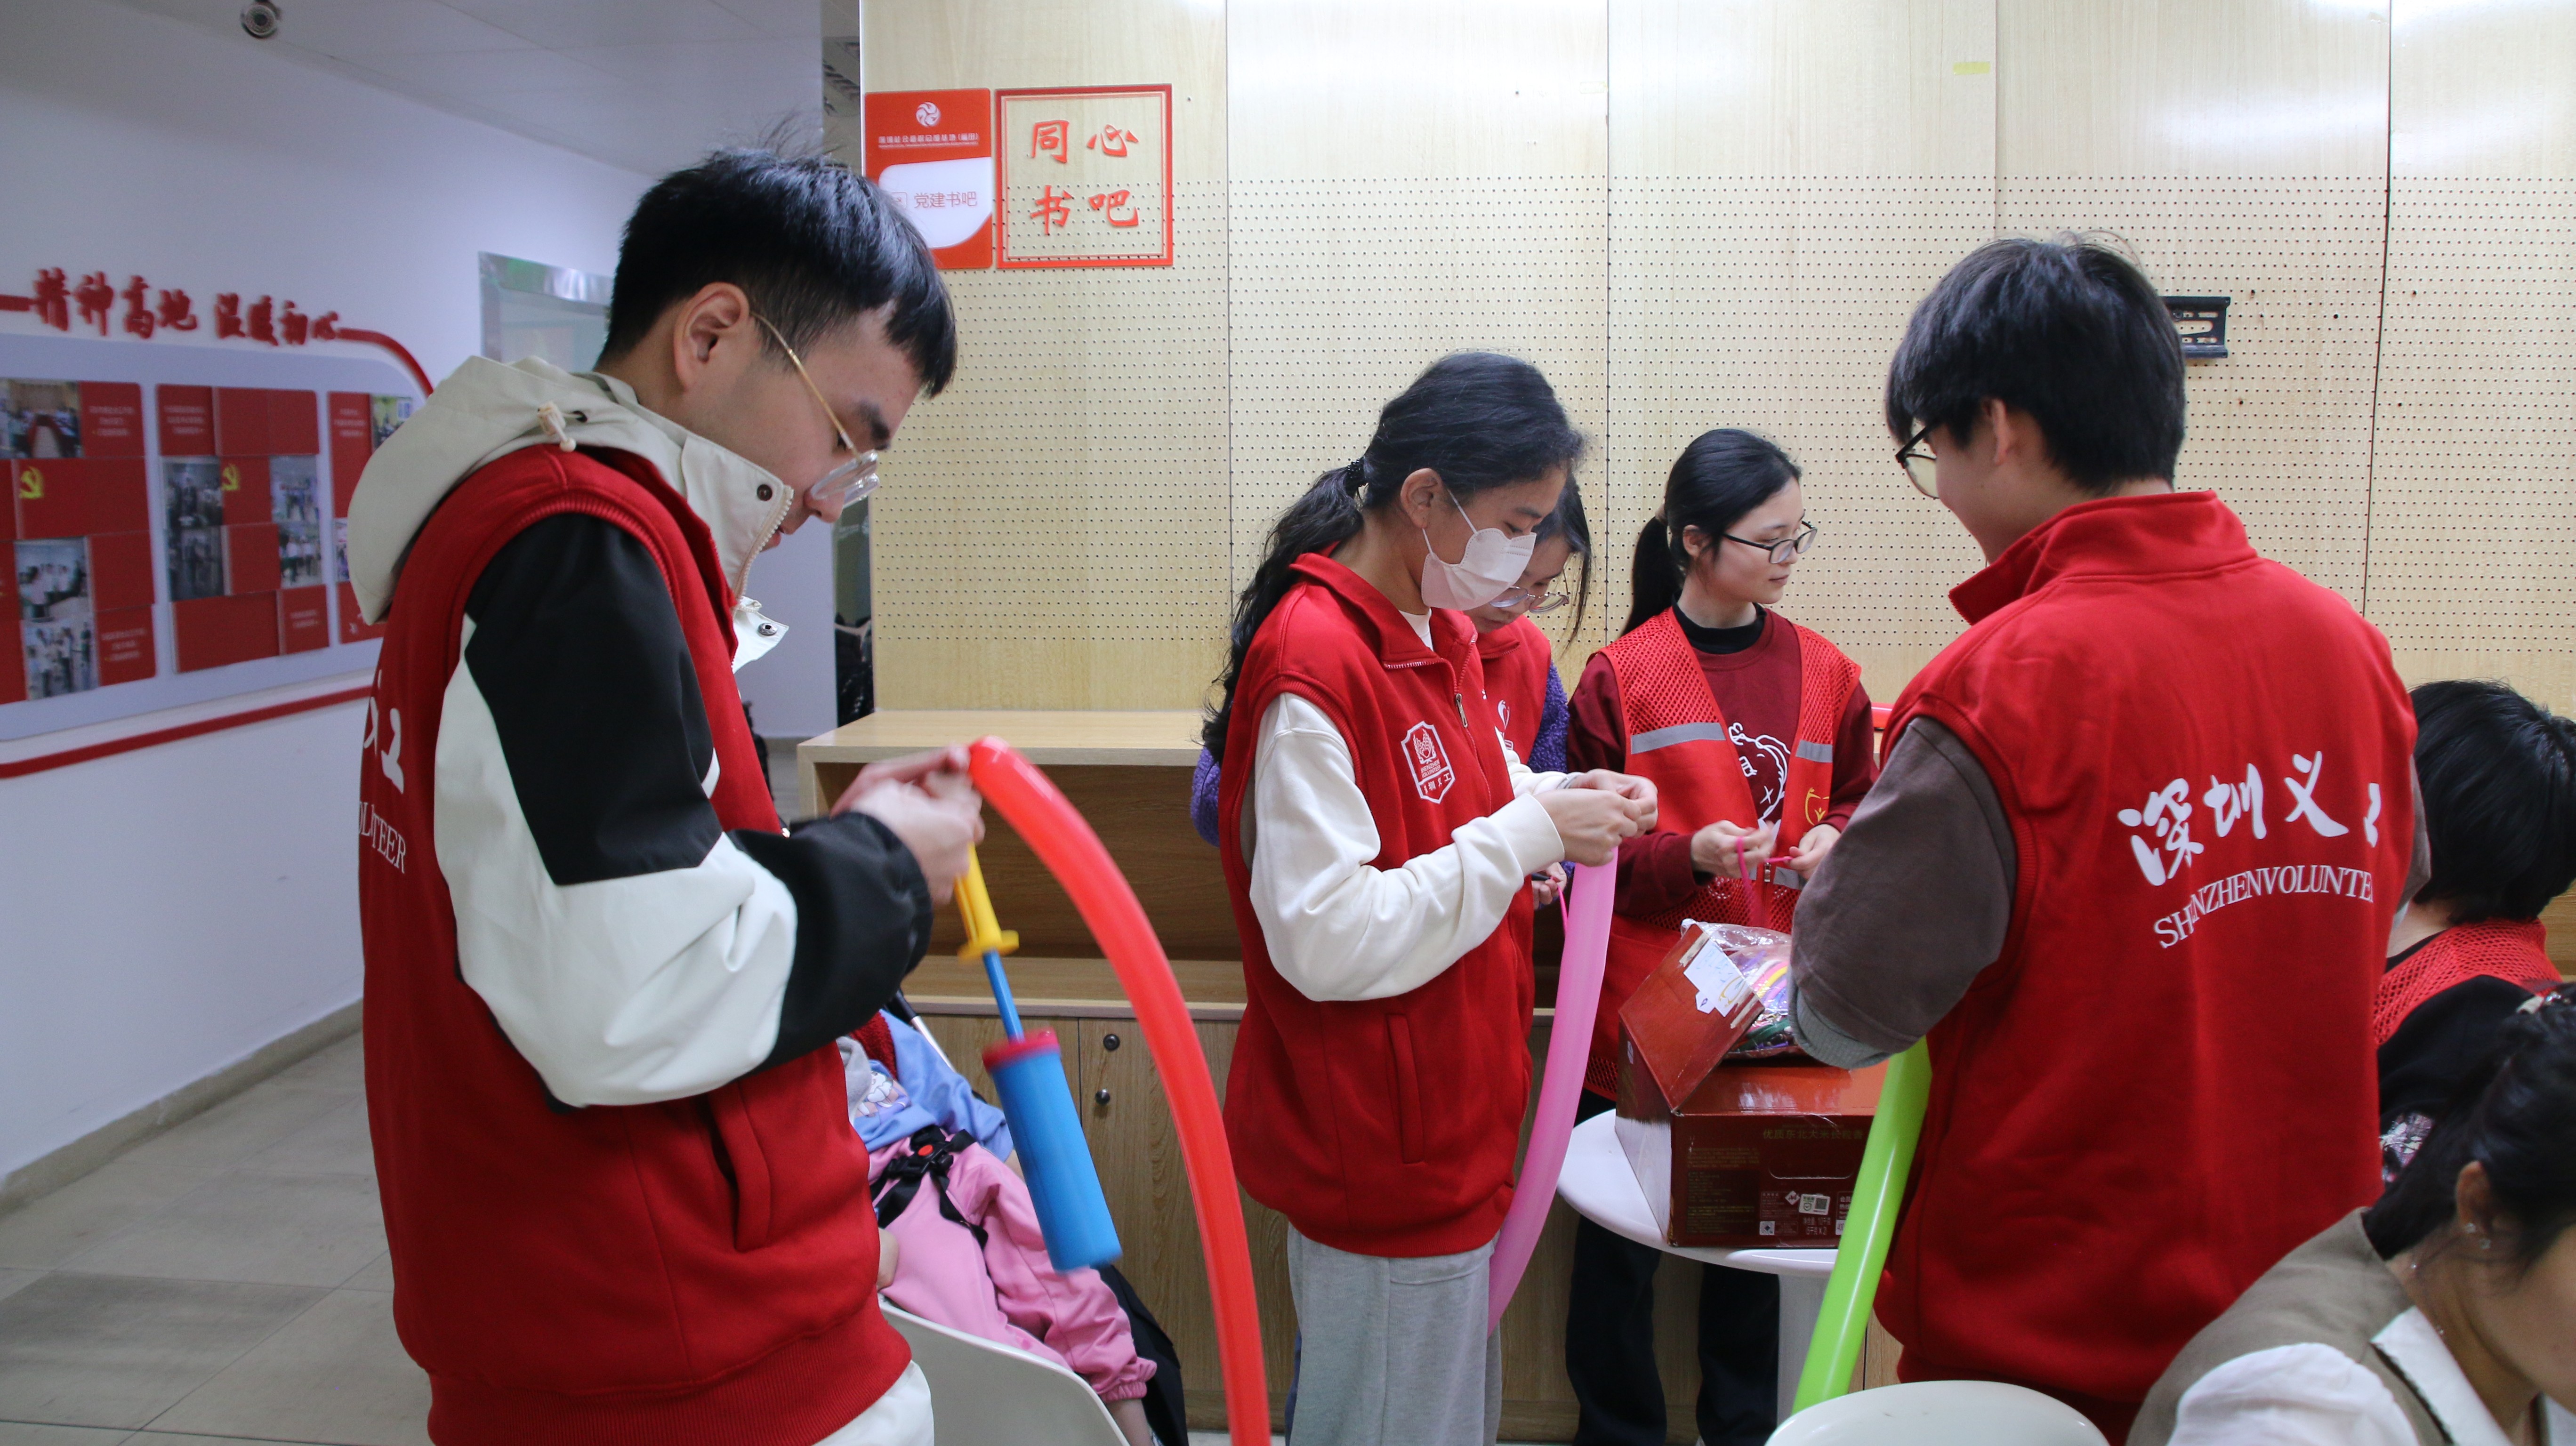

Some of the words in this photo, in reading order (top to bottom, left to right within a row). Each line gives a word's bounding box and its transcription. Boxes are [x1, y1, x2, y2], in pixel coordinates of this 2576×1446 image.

[1031, 120, 1139, 163] 同心
[914, 192, 977, 208] 党建书吧
[1030, 185, 1139, 235] 书吧
[33, 267, 198, 339] 精神高地
